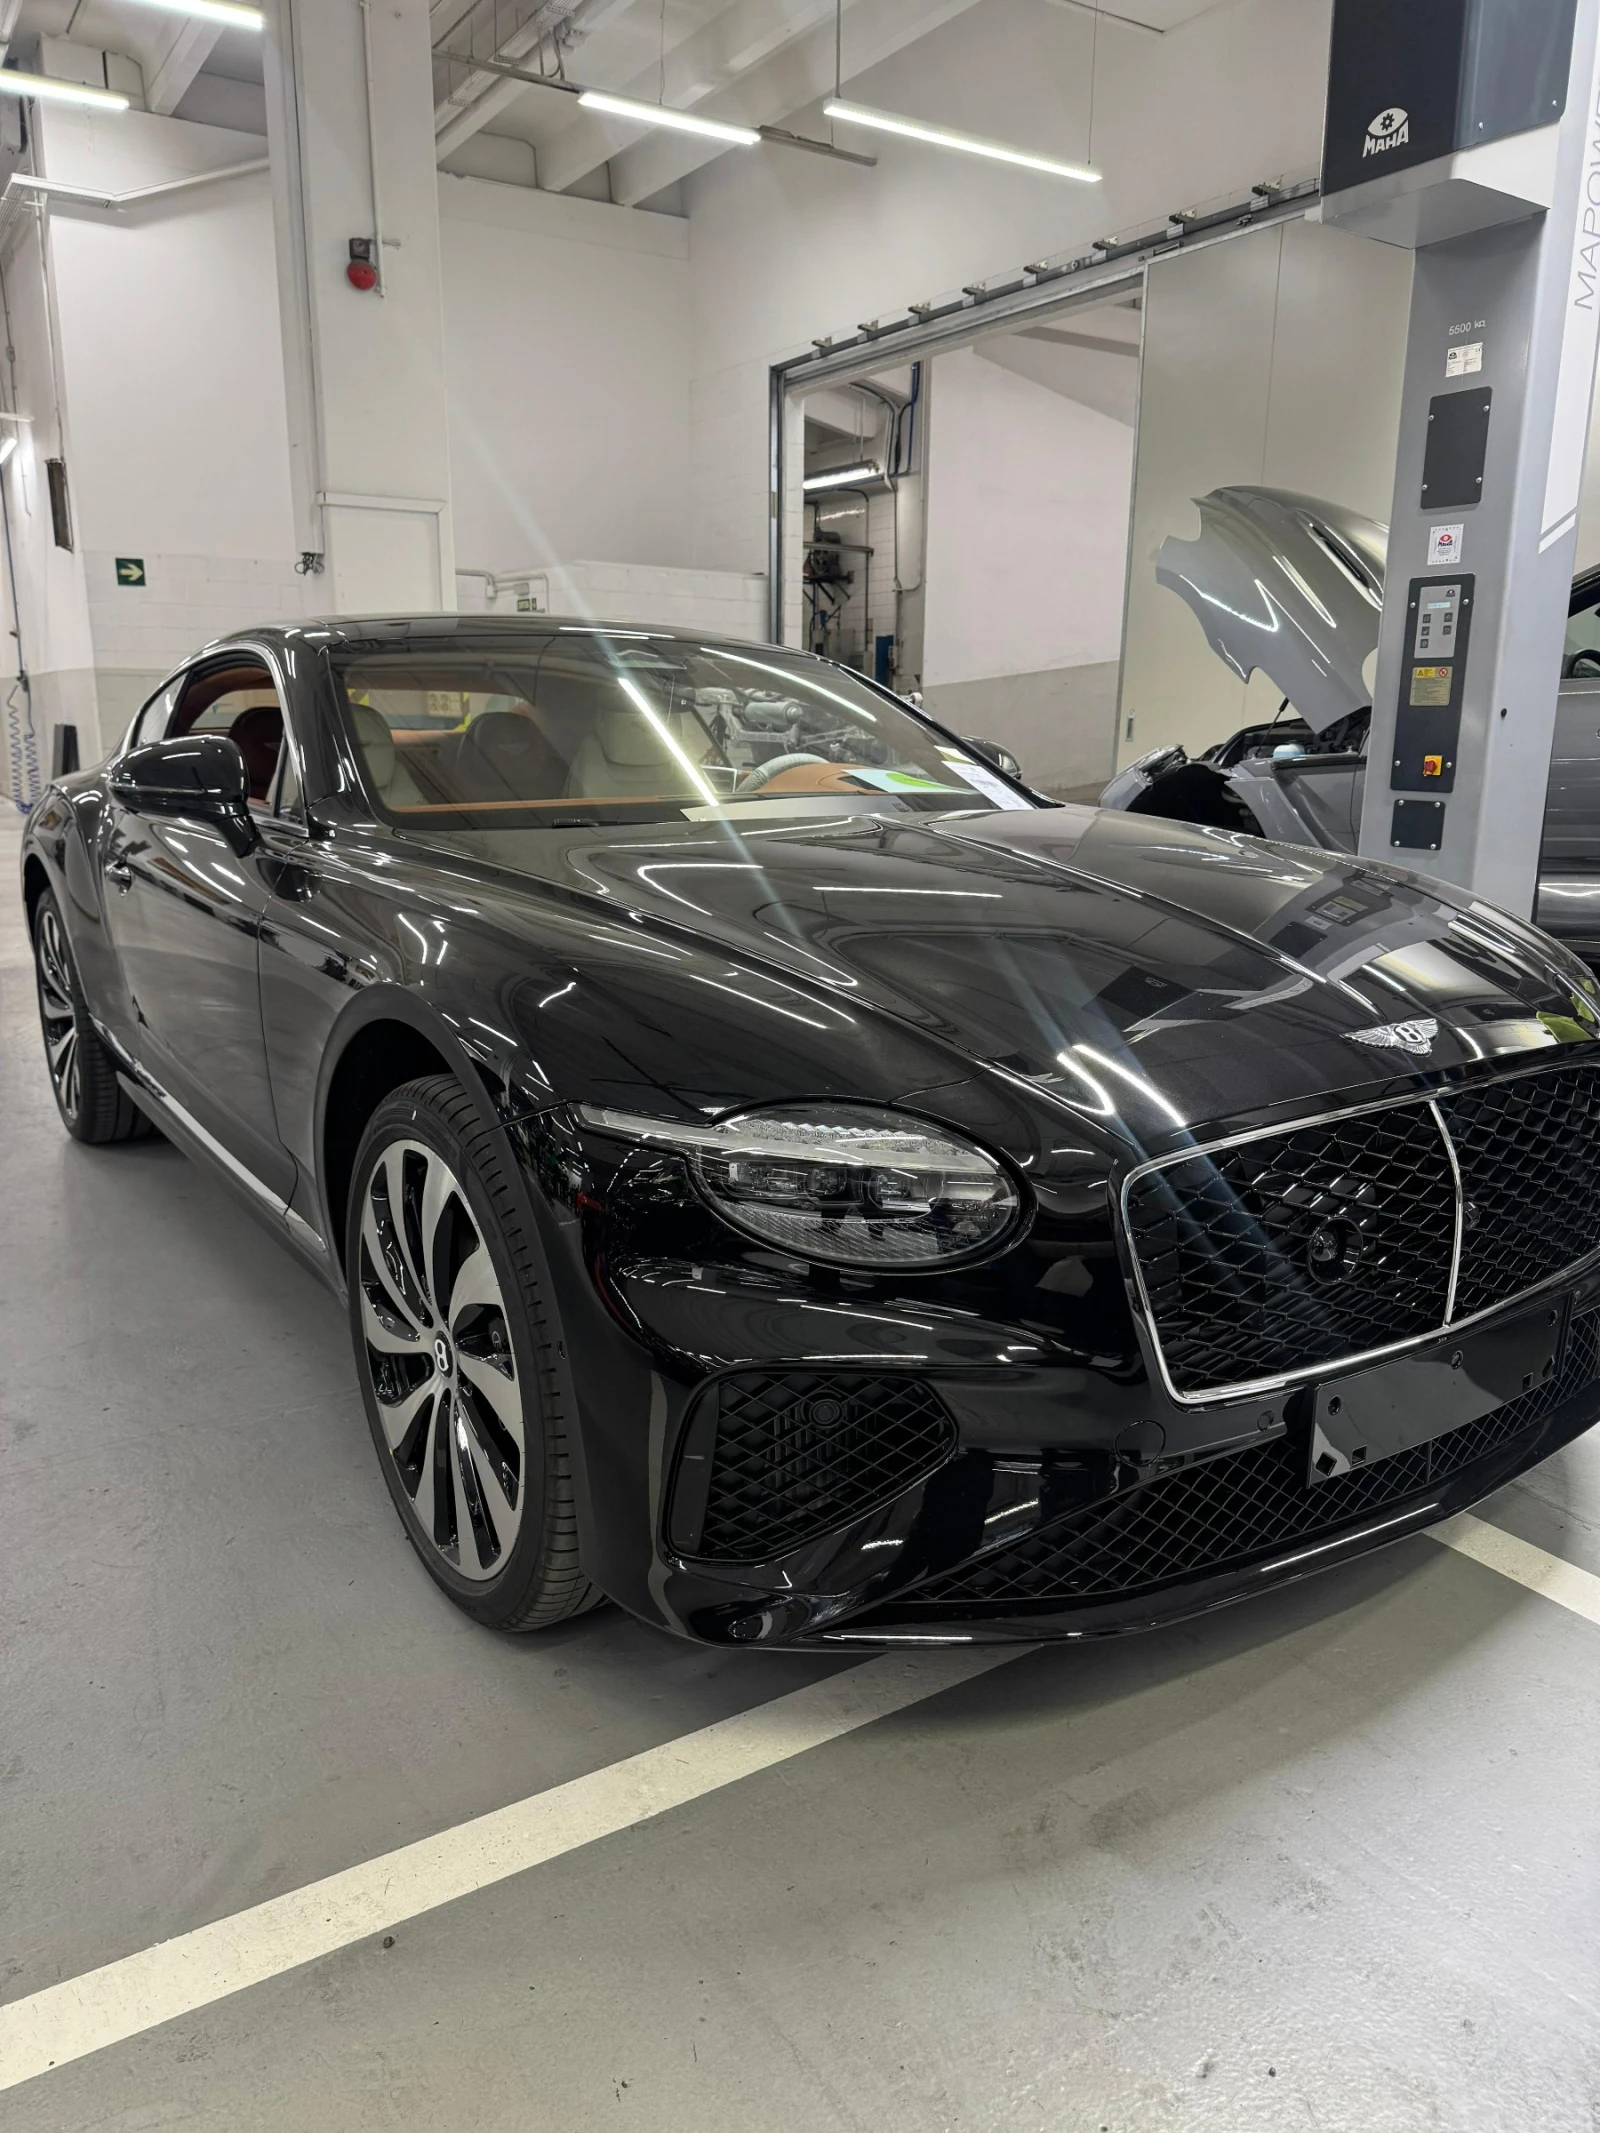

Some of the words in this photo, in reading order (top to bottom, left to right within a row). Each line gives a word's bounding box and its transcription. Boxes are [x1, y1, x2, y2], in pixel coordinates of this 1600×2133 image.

[1362, 119, 1409, 158] MAHA
[1448, 321, 1472, 336] 5500
[434, 1338, 449, 1372] B
